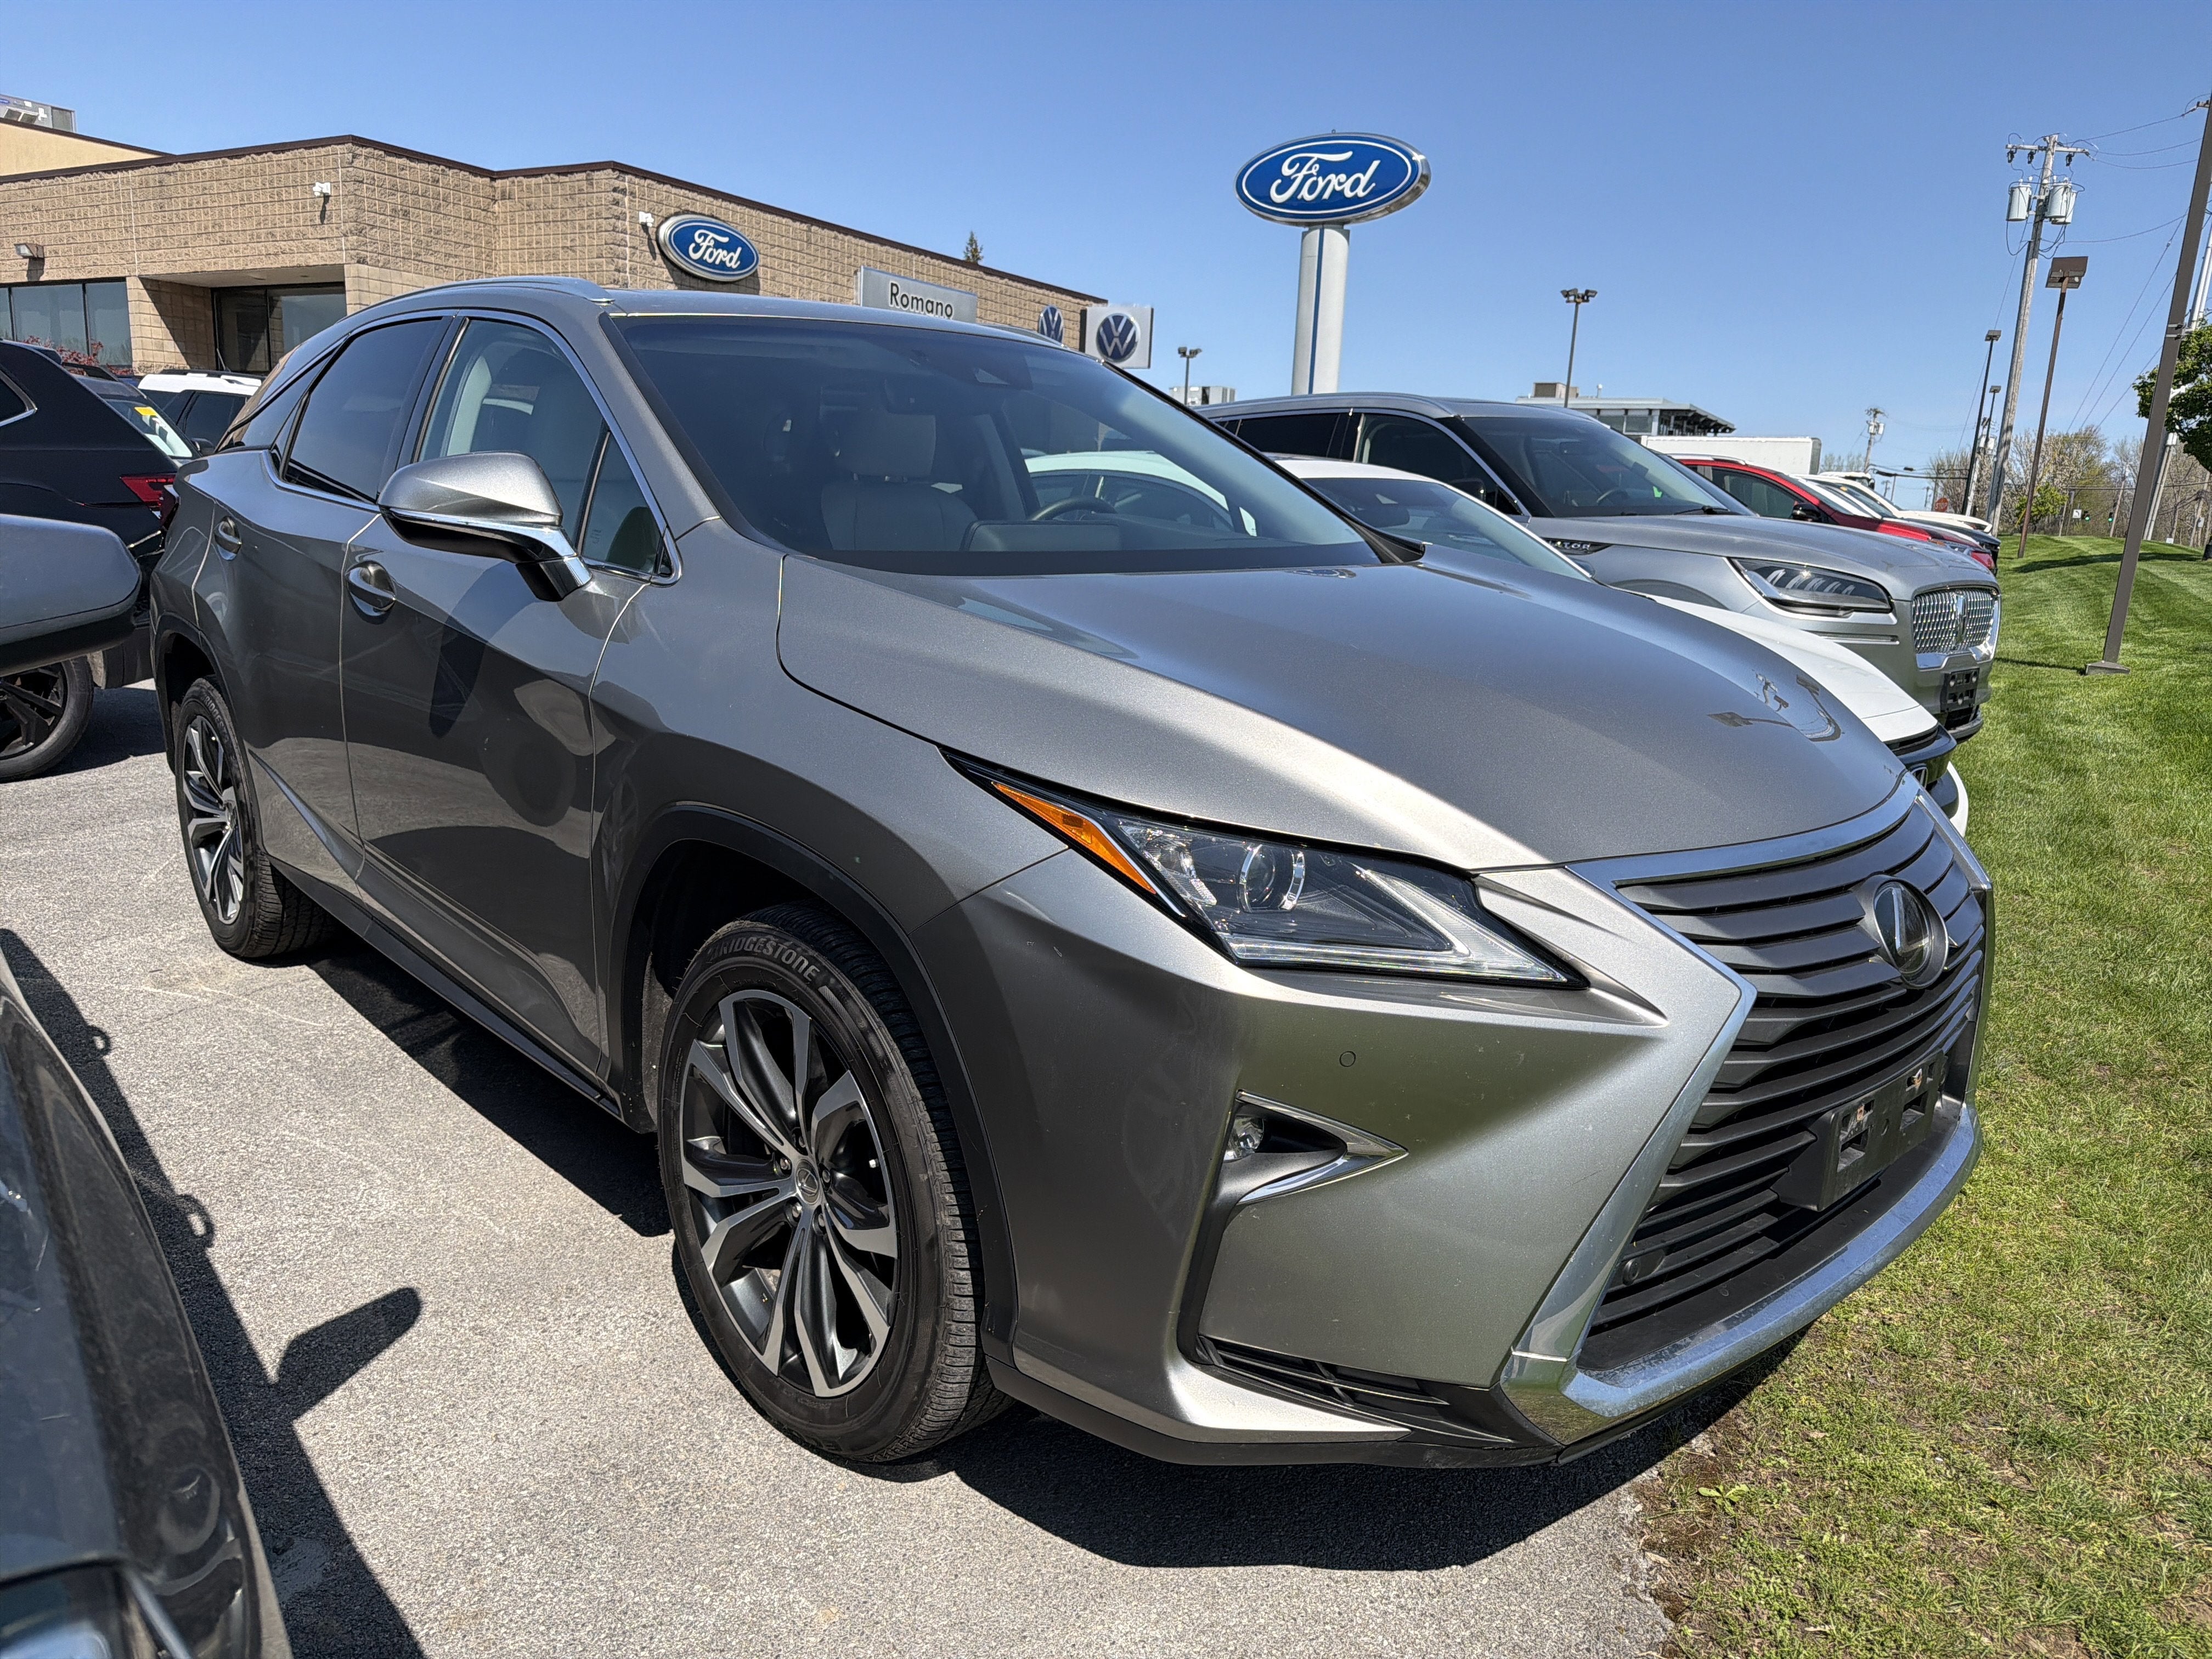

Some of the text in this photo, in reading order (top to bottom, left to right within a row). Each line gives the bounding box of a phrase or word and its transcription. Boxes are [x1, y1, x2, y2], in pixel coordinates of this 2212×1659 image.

[1269, 151, 1381, 204] Ford
[689, 229, 742, 269] Ford
[889, 281, 953, 319] Romano
